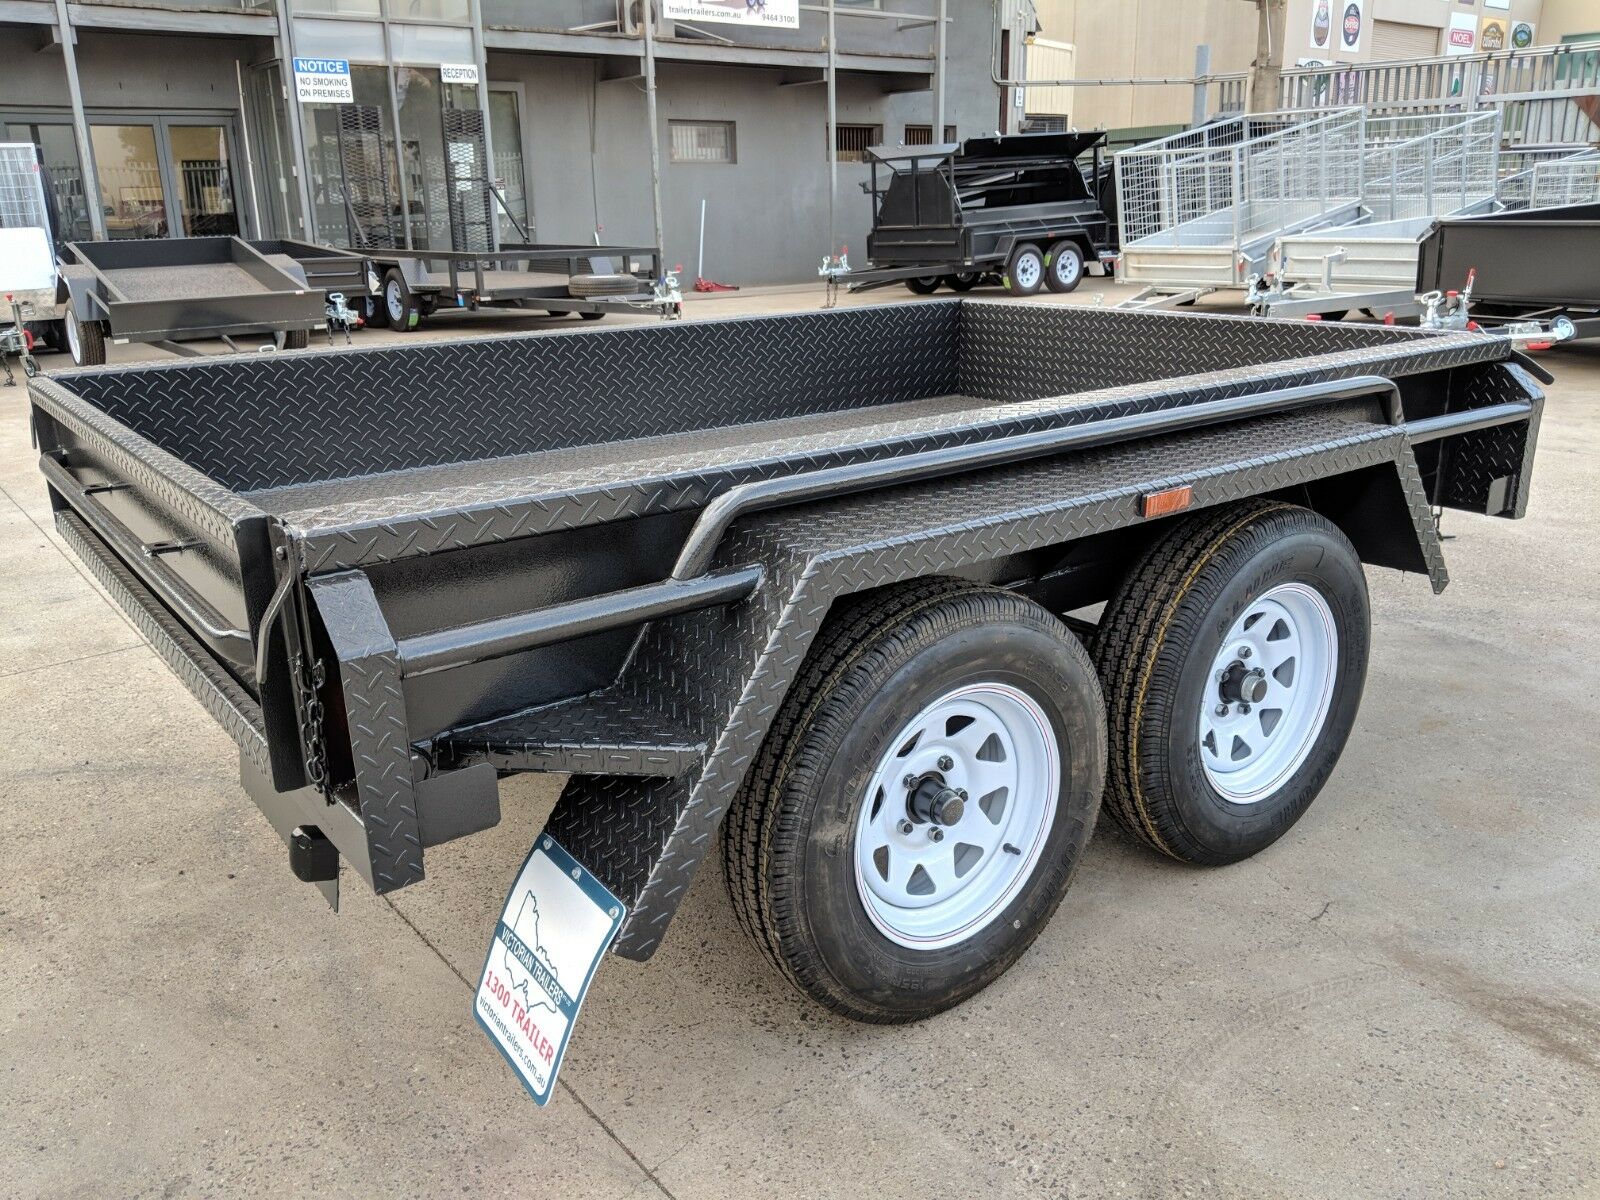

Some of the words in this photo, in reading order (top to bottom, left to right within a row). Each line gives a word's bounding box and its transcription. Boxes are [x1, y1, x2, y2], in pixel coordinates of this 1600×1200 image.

[668, 6, 742, 19] trailertrailers.com.au
[762, 13, 778, 22] 9464
[779, 15, 795, 24] 3100
[1452, 32, 1471, 44] NOEL
[298, 60, 345, 73] NOTICE
[442, 67, 477, 79] RECEPTION
[299, 77, 312, 86] NO
[312, 78, 348, 87] SMOKING
[299, 89, 311, 97] ON
[312, 89, 351, 98] PREMISES
[501, 926, 535, 971] VICTORIAN
[532, 960, 563, 1006] TRAILERS
[485, 970, 511, 1008] 1300
[511, 999, 554, 1066] TRAILER
[479, 995, 545, 1089] victoriantrailers.com.au
